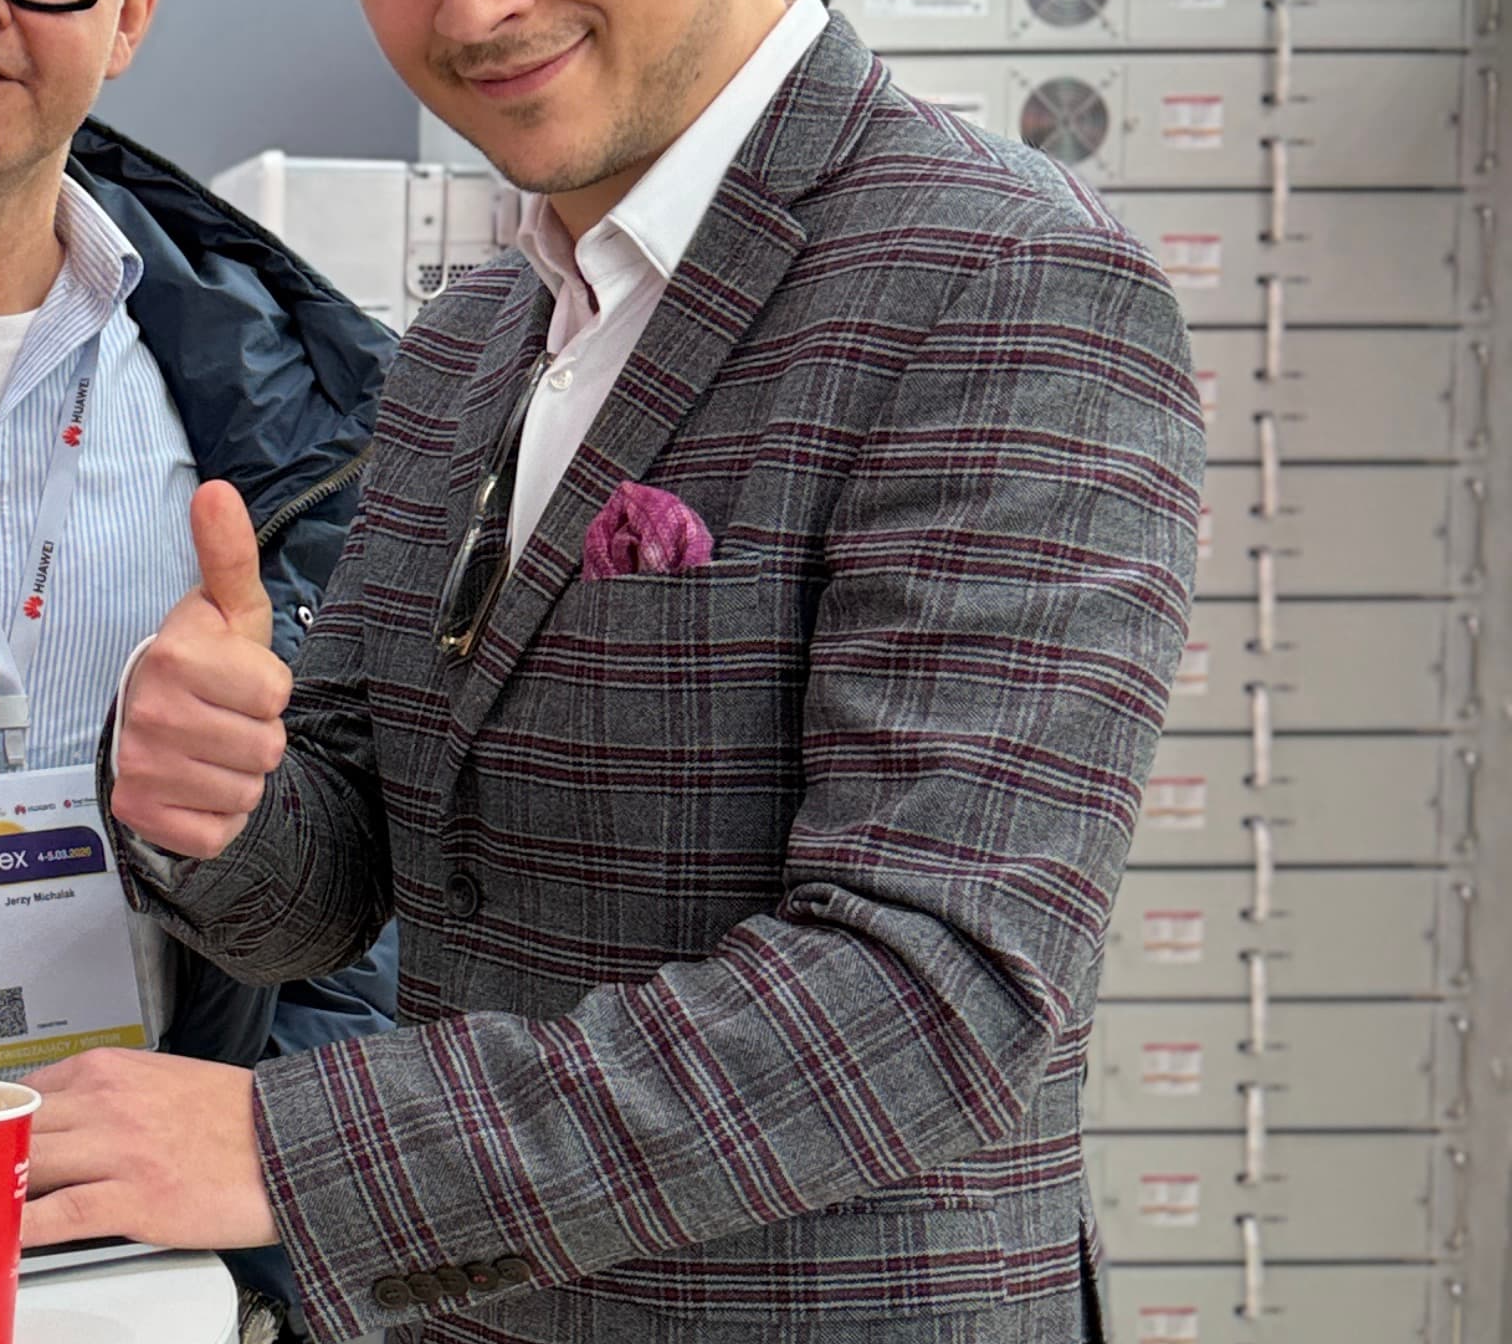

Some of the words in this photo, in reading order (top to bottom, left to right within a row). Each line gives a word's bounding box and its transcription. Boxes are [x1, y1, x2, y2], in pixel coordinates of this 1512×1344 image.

[71, 377, 90, 423] HUAWEI
[33, 540, 54, 593] HUAWEI
[4, 894, 32, 907] Jerzy
